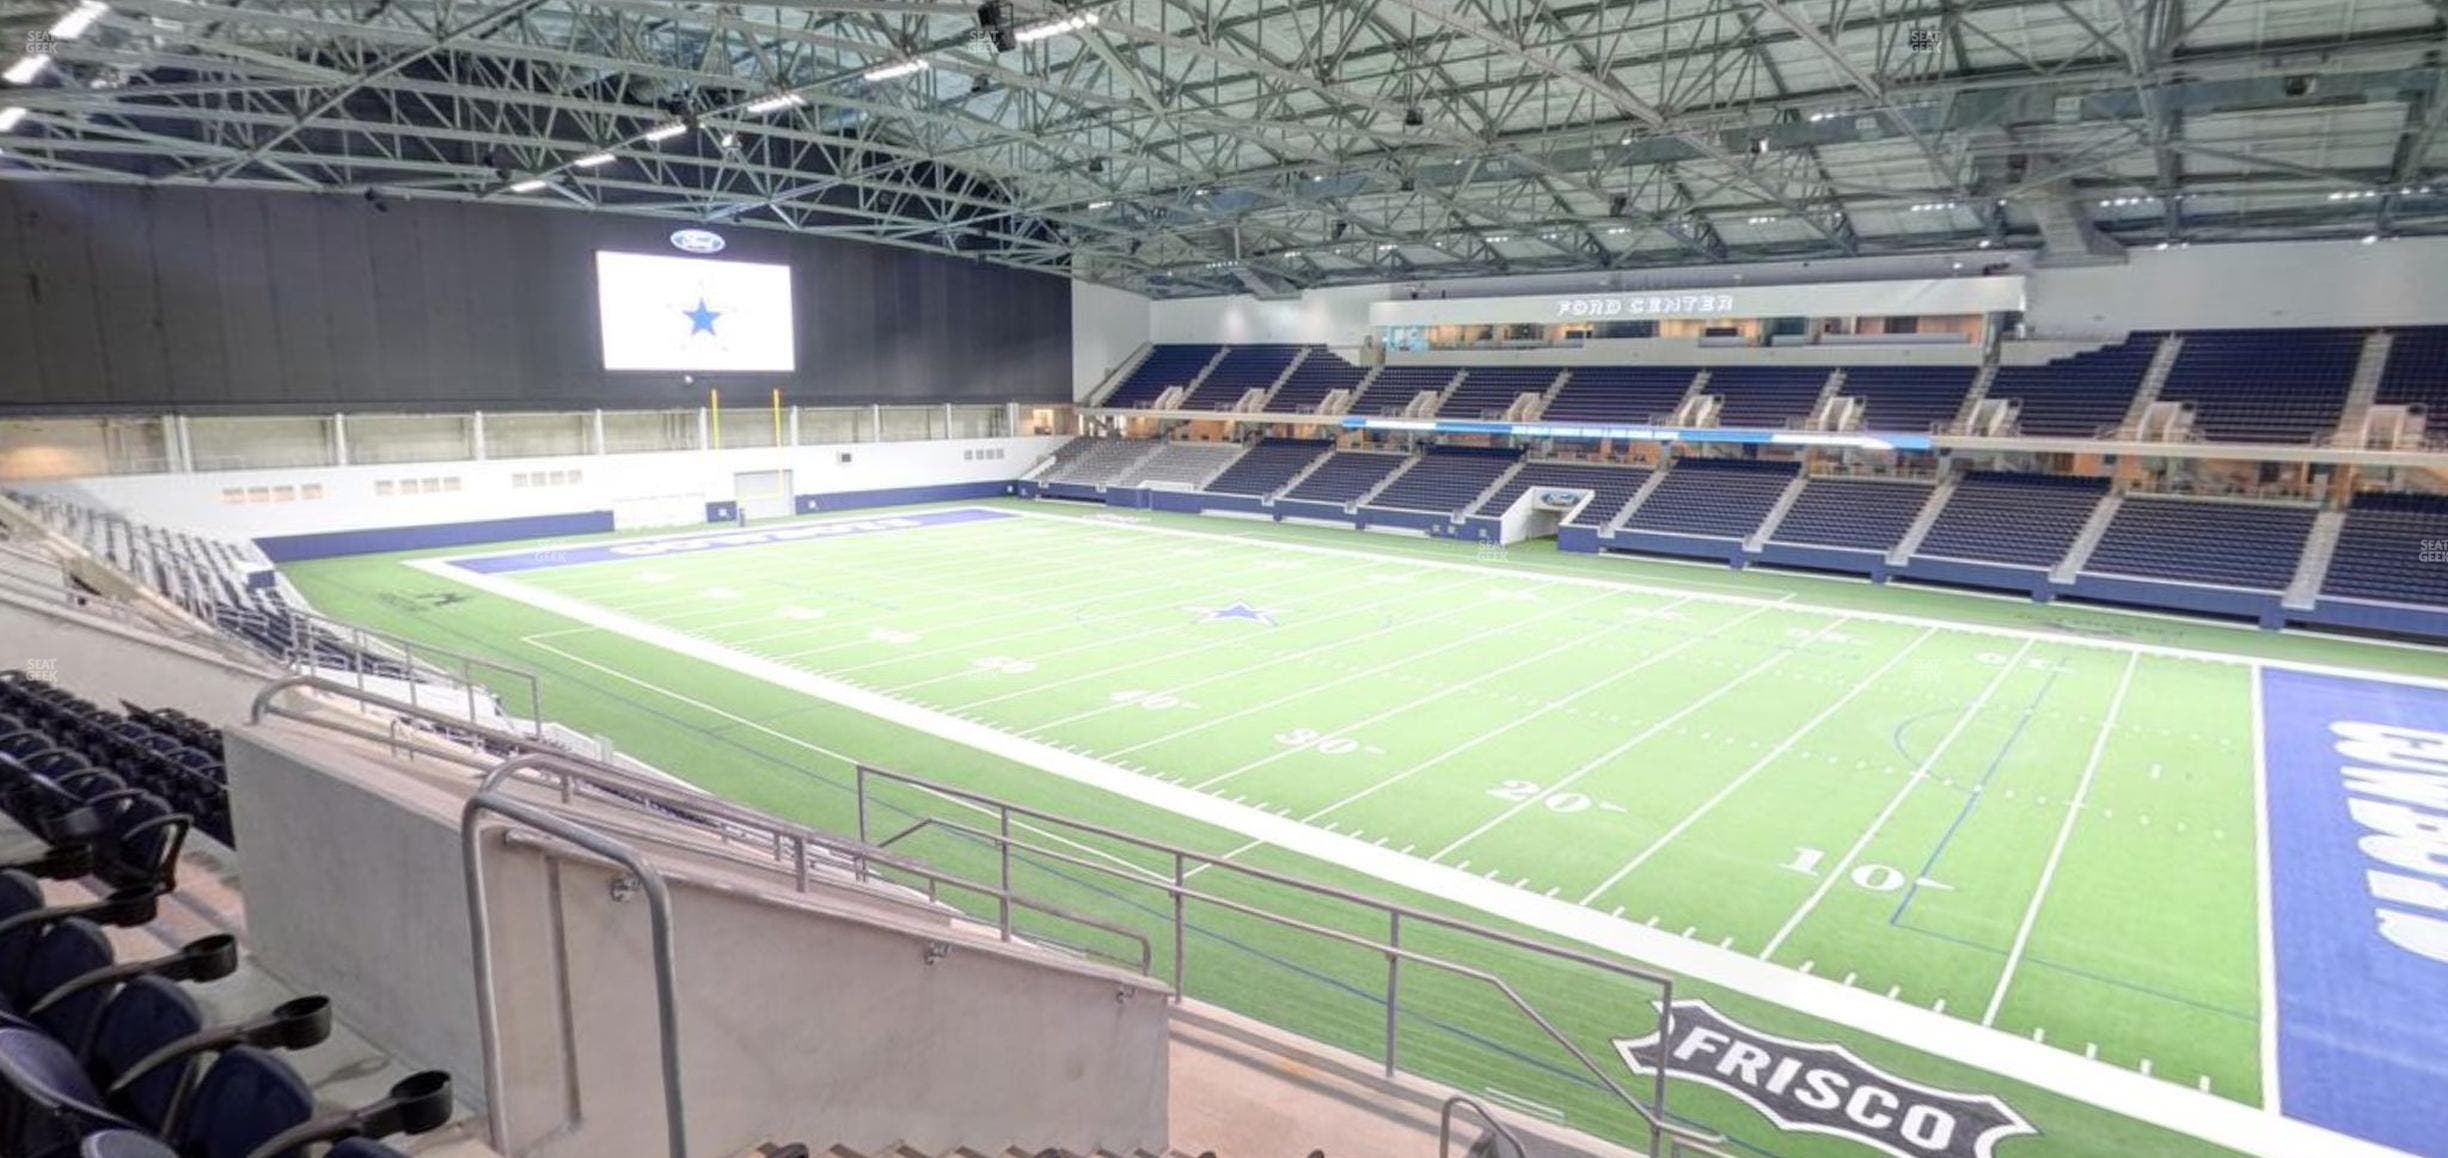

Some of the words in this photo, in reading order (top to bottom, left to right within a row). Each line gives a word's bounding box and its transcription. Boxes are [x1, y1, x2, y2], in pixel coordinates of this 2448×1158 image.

[1557, 299, 1622, 317] FORD
[1629, 295, 1733, 314] CENTER
[1273, 728, 1360, 756] 30
[1485, 779, 1593, 814] 20
[1776, 845, 1907, 892] 10
[1672, 1026, 1957, 1150] FRISCO
